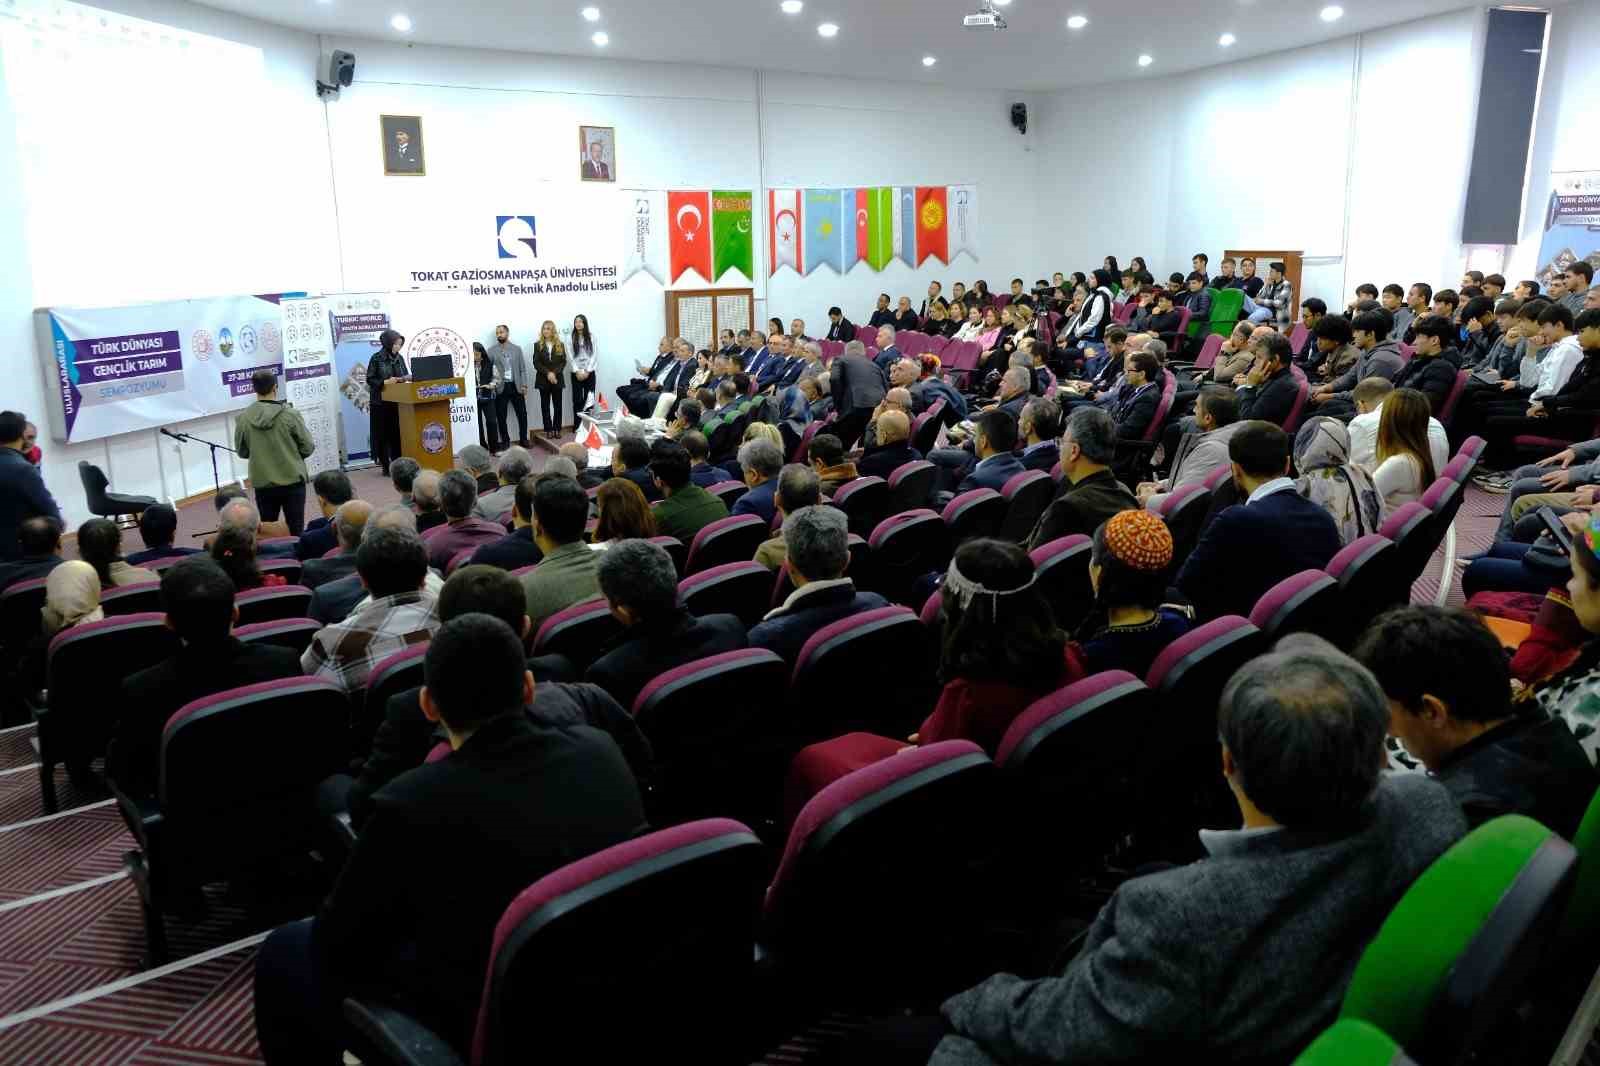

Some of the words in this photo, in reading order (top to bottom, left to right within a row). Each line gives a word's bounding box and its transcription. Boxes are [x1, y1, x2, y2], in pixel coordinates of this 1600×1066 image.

[1577, 196, 1600, 204] DÜNYA
[411, 271, 449, 281] TOKAT
[451, 268, 547, 281] GAZİOSMANPAŞA
[550, 265, 617, 279] ÜNİVERSİTESİ
[493, 286, 506, 295] ve
[508, 283, 543, 295] Teknik
[546, 282, 588, 292] Anadolu
[591, 281, 617, 291] Lisesi
[91, 341, 120, 354] TÜRK
[121, 337, 163, 351] DÜNYASI
[93, 362, 137, 376] GENÇLİK
[138, 358, 167, 370] TARIM
[56, 340, 73, 414] ULUSLARARASI
[99, 380, 167, 398] SEMPOZYUMU
